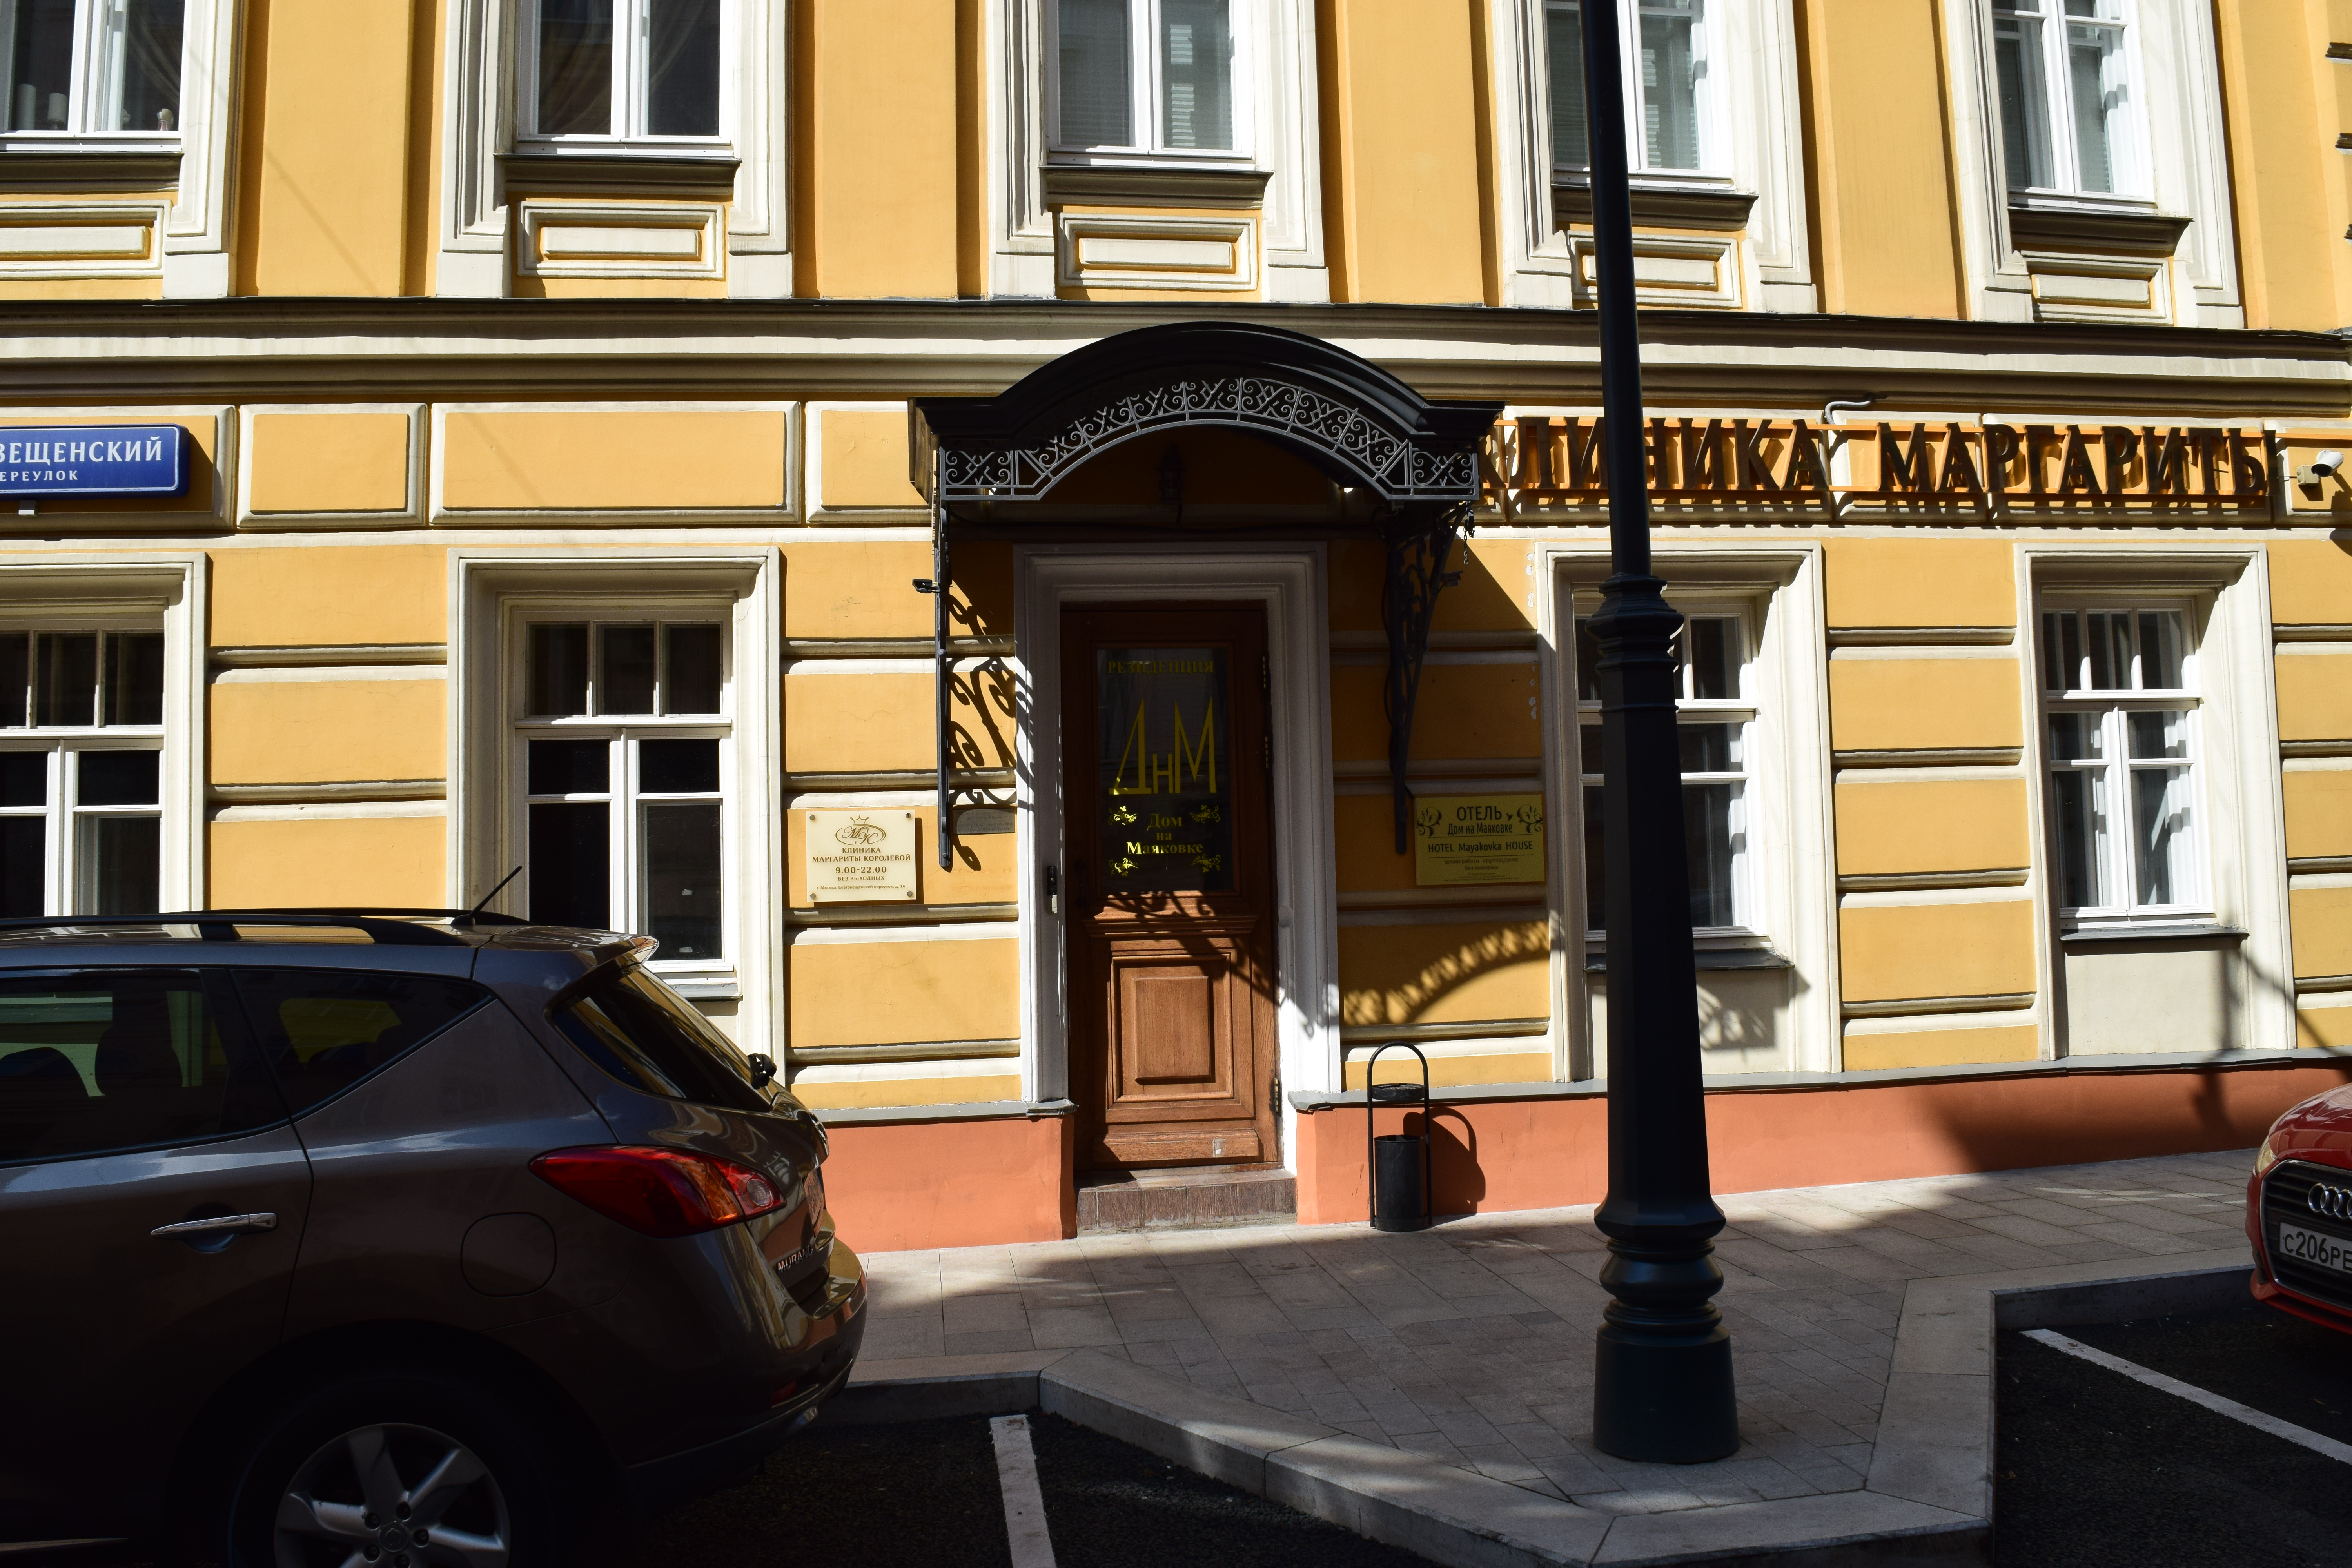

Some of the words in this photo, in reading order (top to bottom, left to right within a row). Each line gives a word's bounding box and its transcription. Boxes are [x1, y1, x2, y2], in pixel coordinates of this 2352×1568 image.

[1877, 422, 2276, 495] МАРГАРИТЫ
[1107, 661, 1214, 675] РЕЗИДЕНЦИЯ
[1457, 806, 1502, 821] ОТЕЛЬ
[1147, 813, 1183, 831] Дом
[1156, 831, 1172, 841] на
[1447, 823, 1463, 836] Дом
[1466, 825, 1474, 834] на
[1476, 823, 1512, 834] Маяковке
[1127, 842, 1203, 855] Маяковке
[1428, 843, 1454, 853] HOTEL
[1458, 842, 1501, 853] Mayakovka
[1506, 841, 1533, 850] HOUSE
[864, 853, 911, 862] КОРОЛЕВОЙ
[776, 1245, 813, 1275] MURANO
